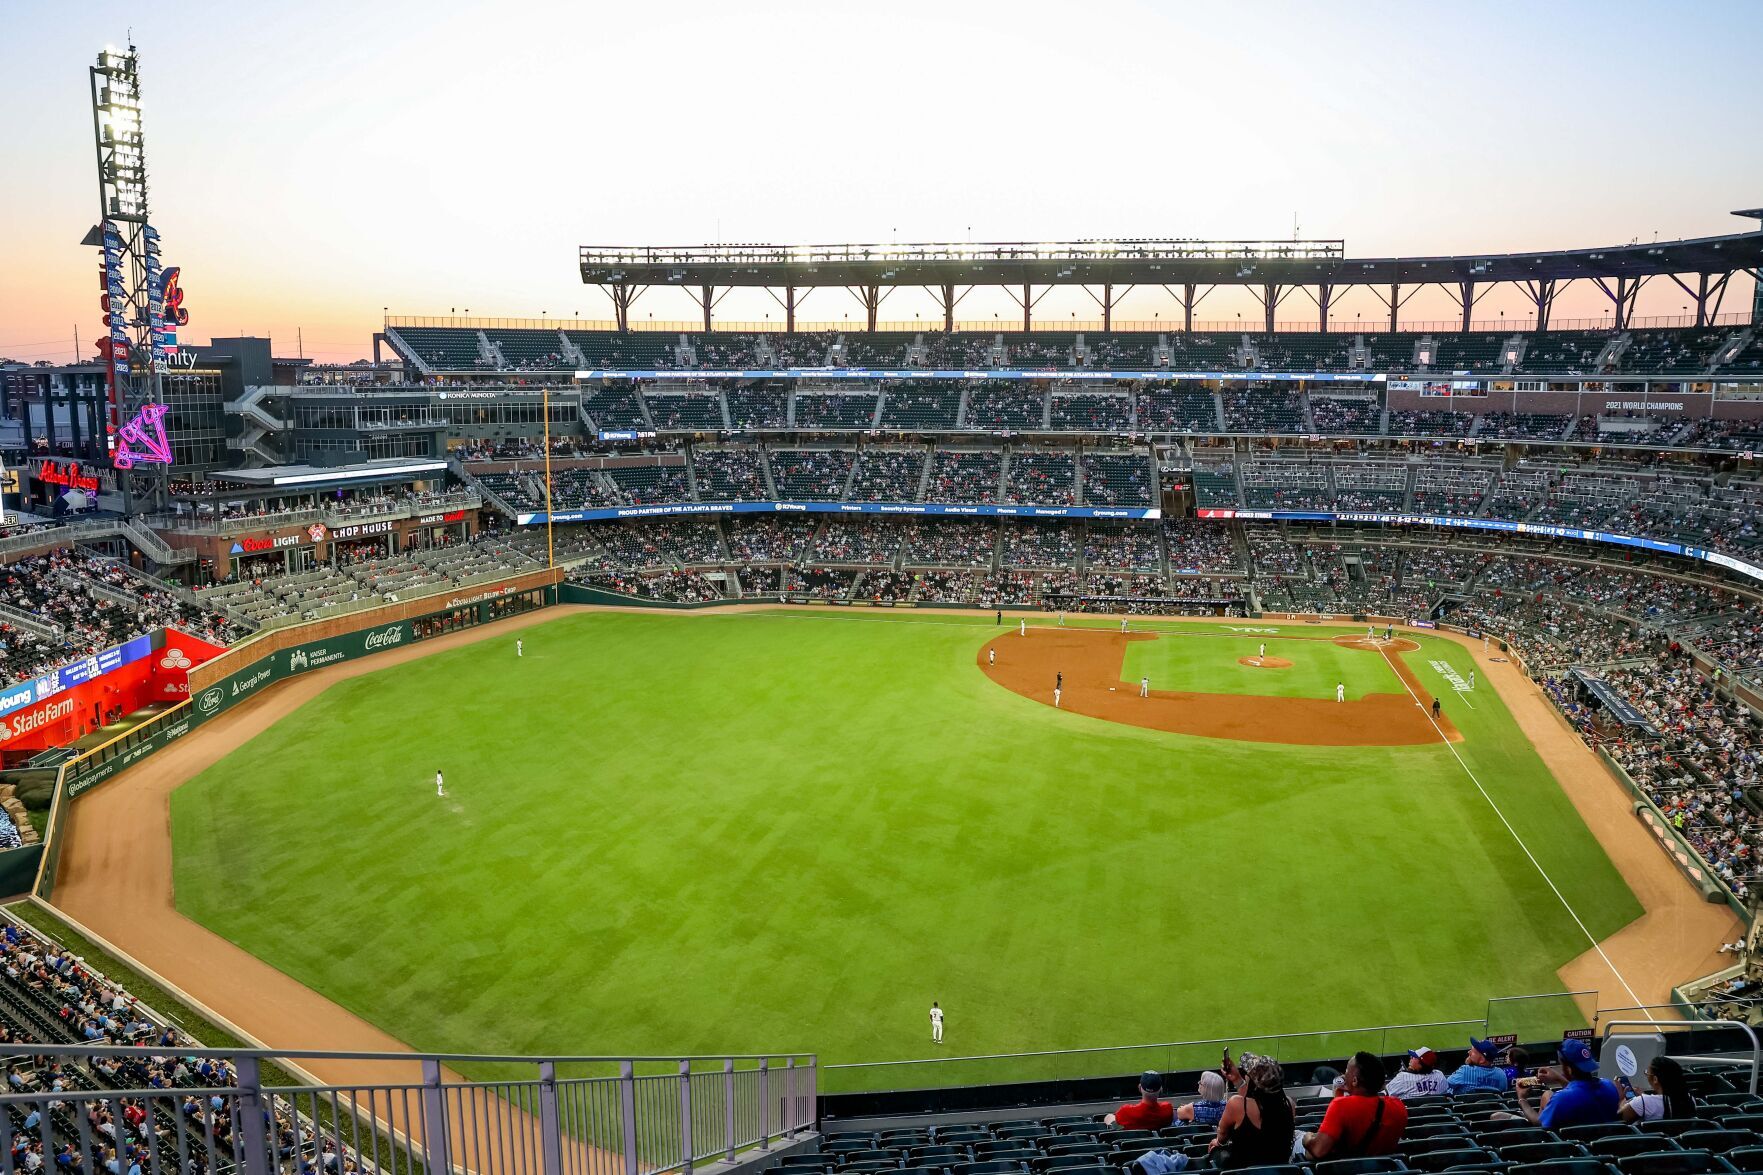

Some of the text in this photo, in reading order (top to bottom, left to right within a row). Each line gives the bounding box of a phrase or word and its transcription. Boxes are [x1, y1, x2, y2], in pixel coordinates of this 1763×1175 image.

[153, 333, 164, 342] 2020
[114, 348, 126, 356] 2021
[153, 347, 165, 357] 2022
[1646, 402, 1684, 410] CHAMPIONS
[39, 460, 98, 490] Atlanta Braves
[420, 516, 434, 524] MADE
[332, 522, 393, 539] CHOP HOUSE
[243, 535, 300, 552] Coors LIGHT
[310, 649, 327, 658] KAISER
[240, 669, 271, 691] Georgia Power
[1416, 1081, 1438, 1092] BAEZ
